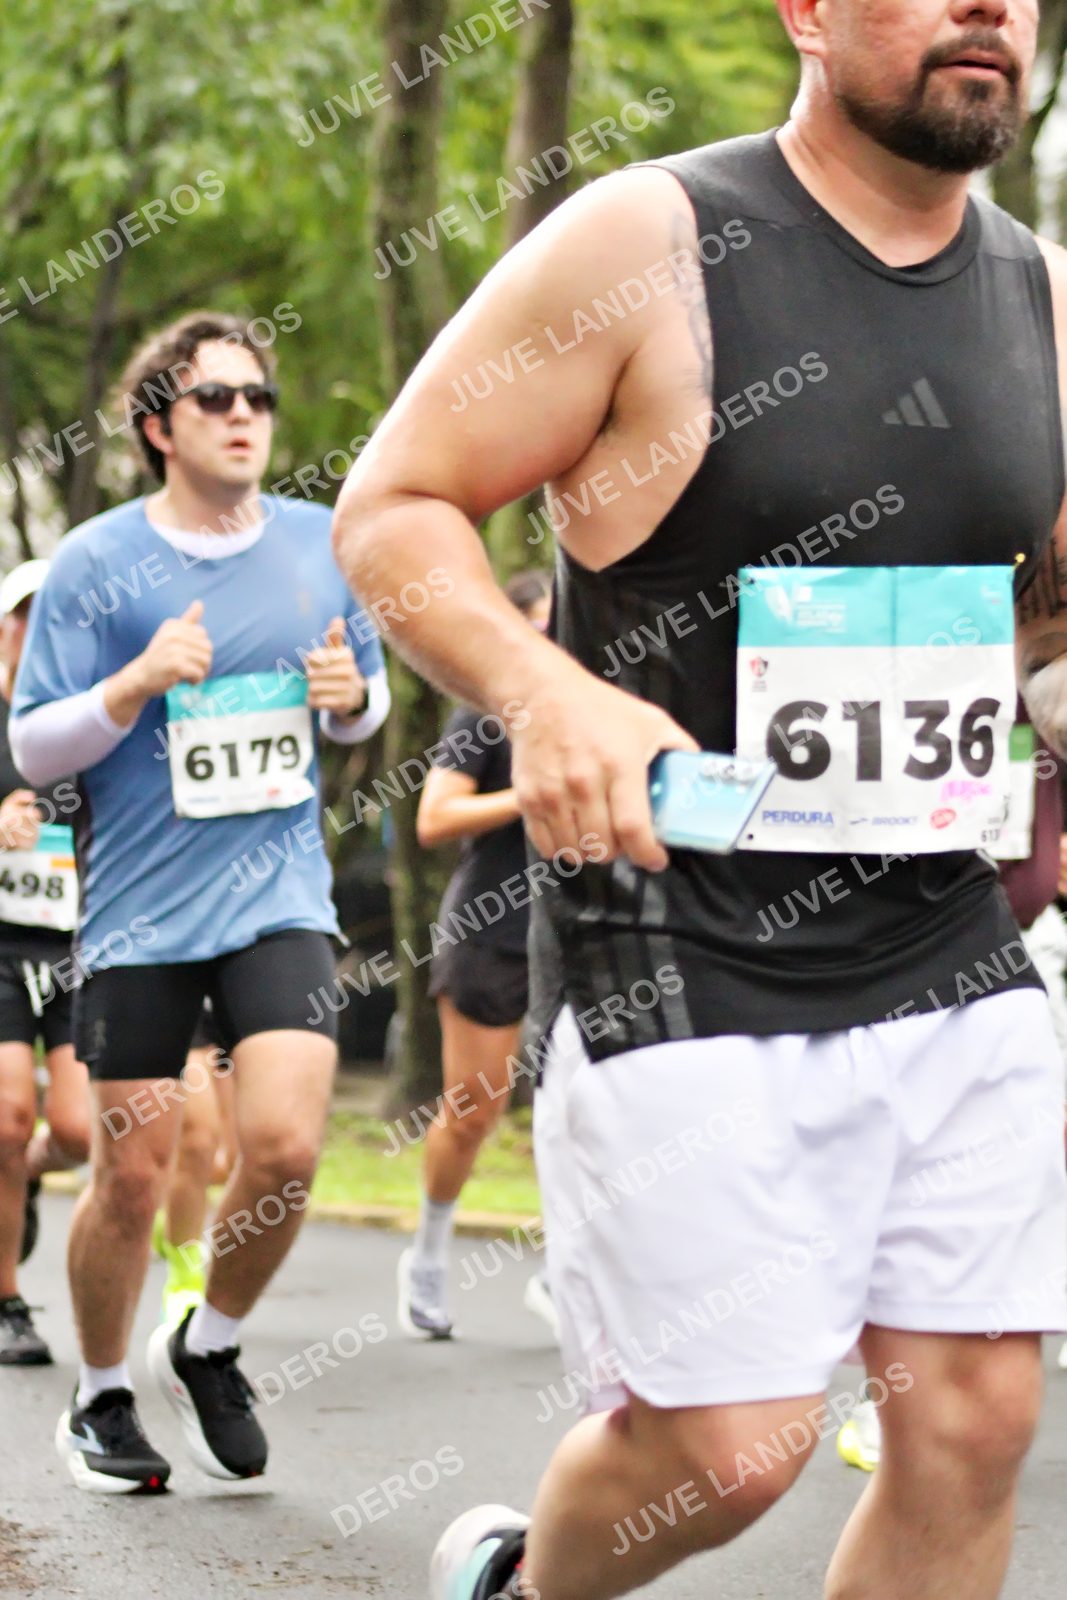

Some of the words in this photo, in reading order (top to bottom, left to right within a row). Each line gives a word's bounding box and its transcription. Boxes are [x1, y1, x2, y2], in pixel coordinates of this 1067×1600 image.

[185, 735, 301, 781] 6179
[766, 697, 1002, 783] 6136
[762, 810, 834, 826] PERDURA
